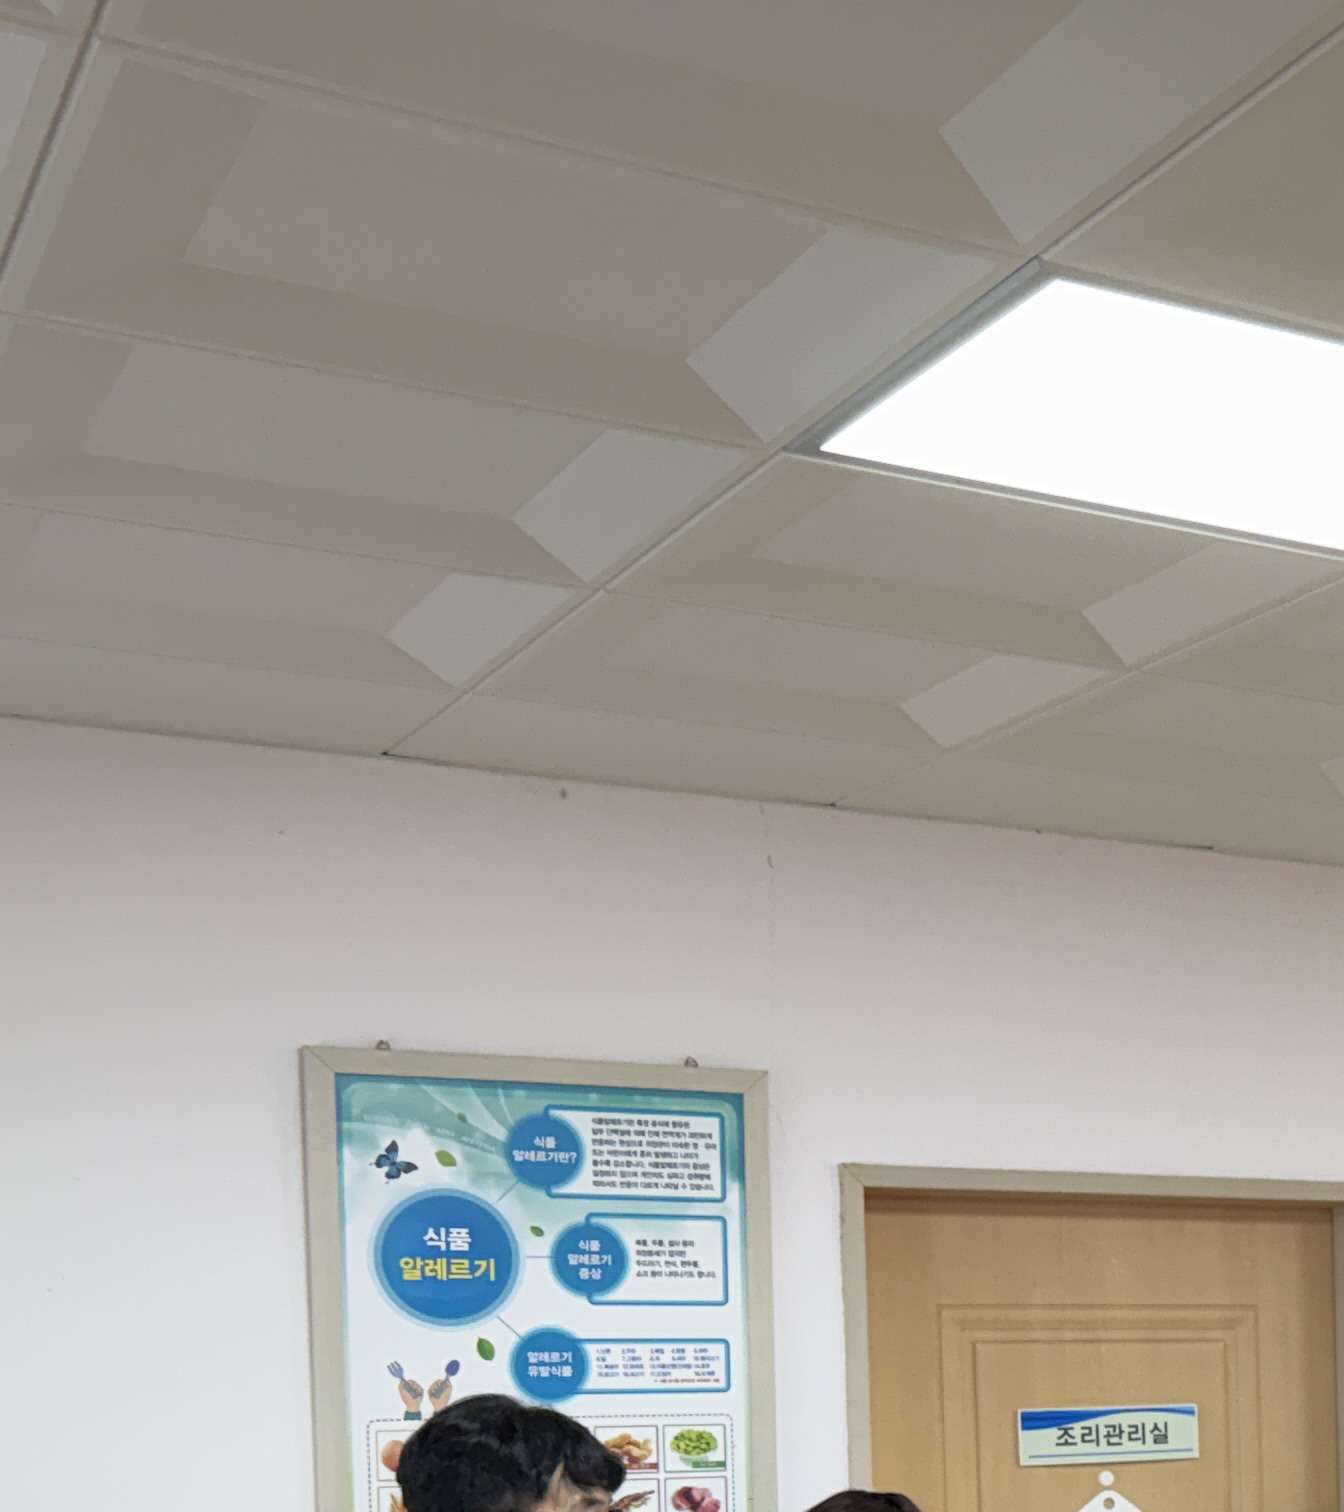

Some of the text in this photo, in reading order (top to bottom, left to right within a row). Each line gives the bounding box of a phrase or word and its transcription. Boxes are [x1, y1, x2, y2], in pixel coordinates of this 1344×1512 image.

[533, 1135, 557, 1148] 식품
[512, 1150, 578, 1164] 알레르기란?
[422, 1226, 472, 1251] 식품
[578, 1240, 601, 1252] 식품
[567, 1254, 612, 1266] 알레르기
[400, 1257, 496, 1282] 알레르기
[526, 1351, 573, 1364] 알레르기
[527, 1365, 573, 1378] 유발식품
[1055, 1421, 1169, 1447] 조리관리실
